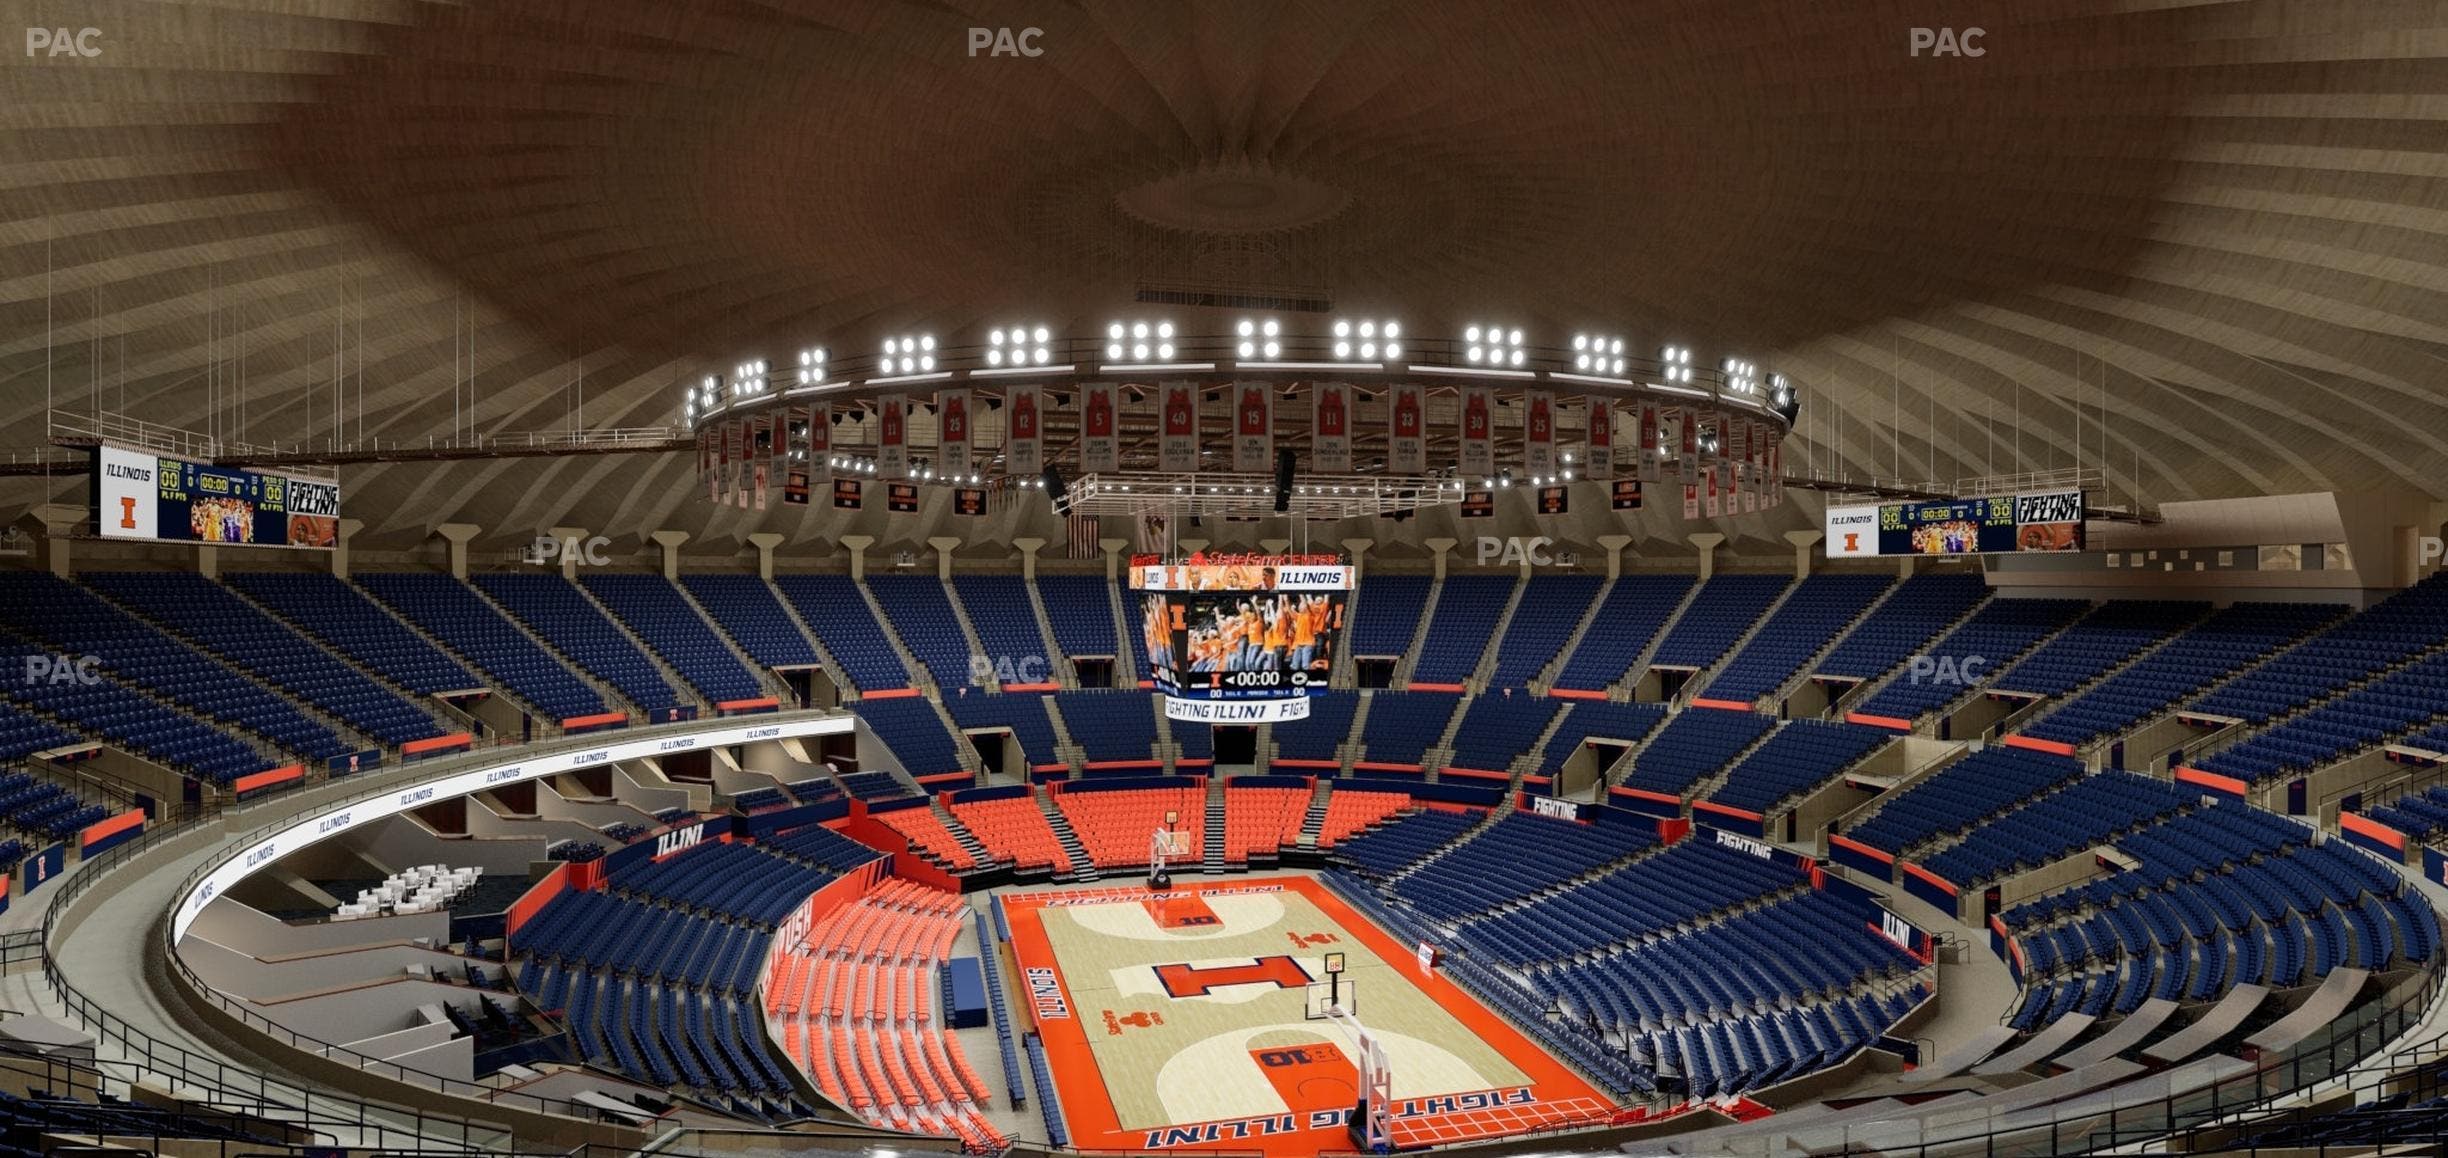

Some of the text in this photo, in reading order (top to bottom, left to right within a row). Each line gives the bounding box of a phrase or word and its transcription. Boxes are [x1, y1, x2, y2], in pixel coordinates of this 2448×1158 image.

[106, 463, 152, 482] ILLINOIS
[161, 471, 178, 488] 00
[187, 475, 194, 487] 0
[201, 476, 228, 491] 00:00
[234, 484, 241, 495] 0
[251, 485, 258, 496] 0
[266, 486, 282, 501] 00
[289, 481, 338, 502] FIGHTING
[288, 496, 339, 515] ILLINI
[2018, 491, 2080, 511] FIGHTING
[1883, 512, 1898, 523] 00
[1922, 509, 1950, 519] 00:00
[1992, 506, 2010, 517] 00
[2018, 504, 2080, 523] ILLINI
[1831, 515, 1872, 525] ILLINOIS
[1280, 572, 1341, 584] ILLINOIS
[1237, 671, 1280, 686] 00:00
[1210, 689, 1222, 699] 00
[1293, 687, 1305, 697] 00
[1213, 705, 1267, 719] ILLINI
[746, 727, 780, 739] ILLINOIS
[660, 738, 695, 750] ILLINOIS
[573, 751, 608, 764] ILLINOIS
[486, 767, 521, 783] ILLINOIS
[400, 787, 434, 806] ILLINOIS
[1533, 796, 1578, 821] FIGHTING
[319, 813, 351, 834] ILLINOIS
[656, 823, 705, 857] ILLINI
[1715, 830, 1773, 861] FIGHTING
[1882, 910, 1911, 949] ILLINI
[1025, 967, 1071, 1020] ILLINOIS
[1144, 1112, 1297, 1150] ILLINI
